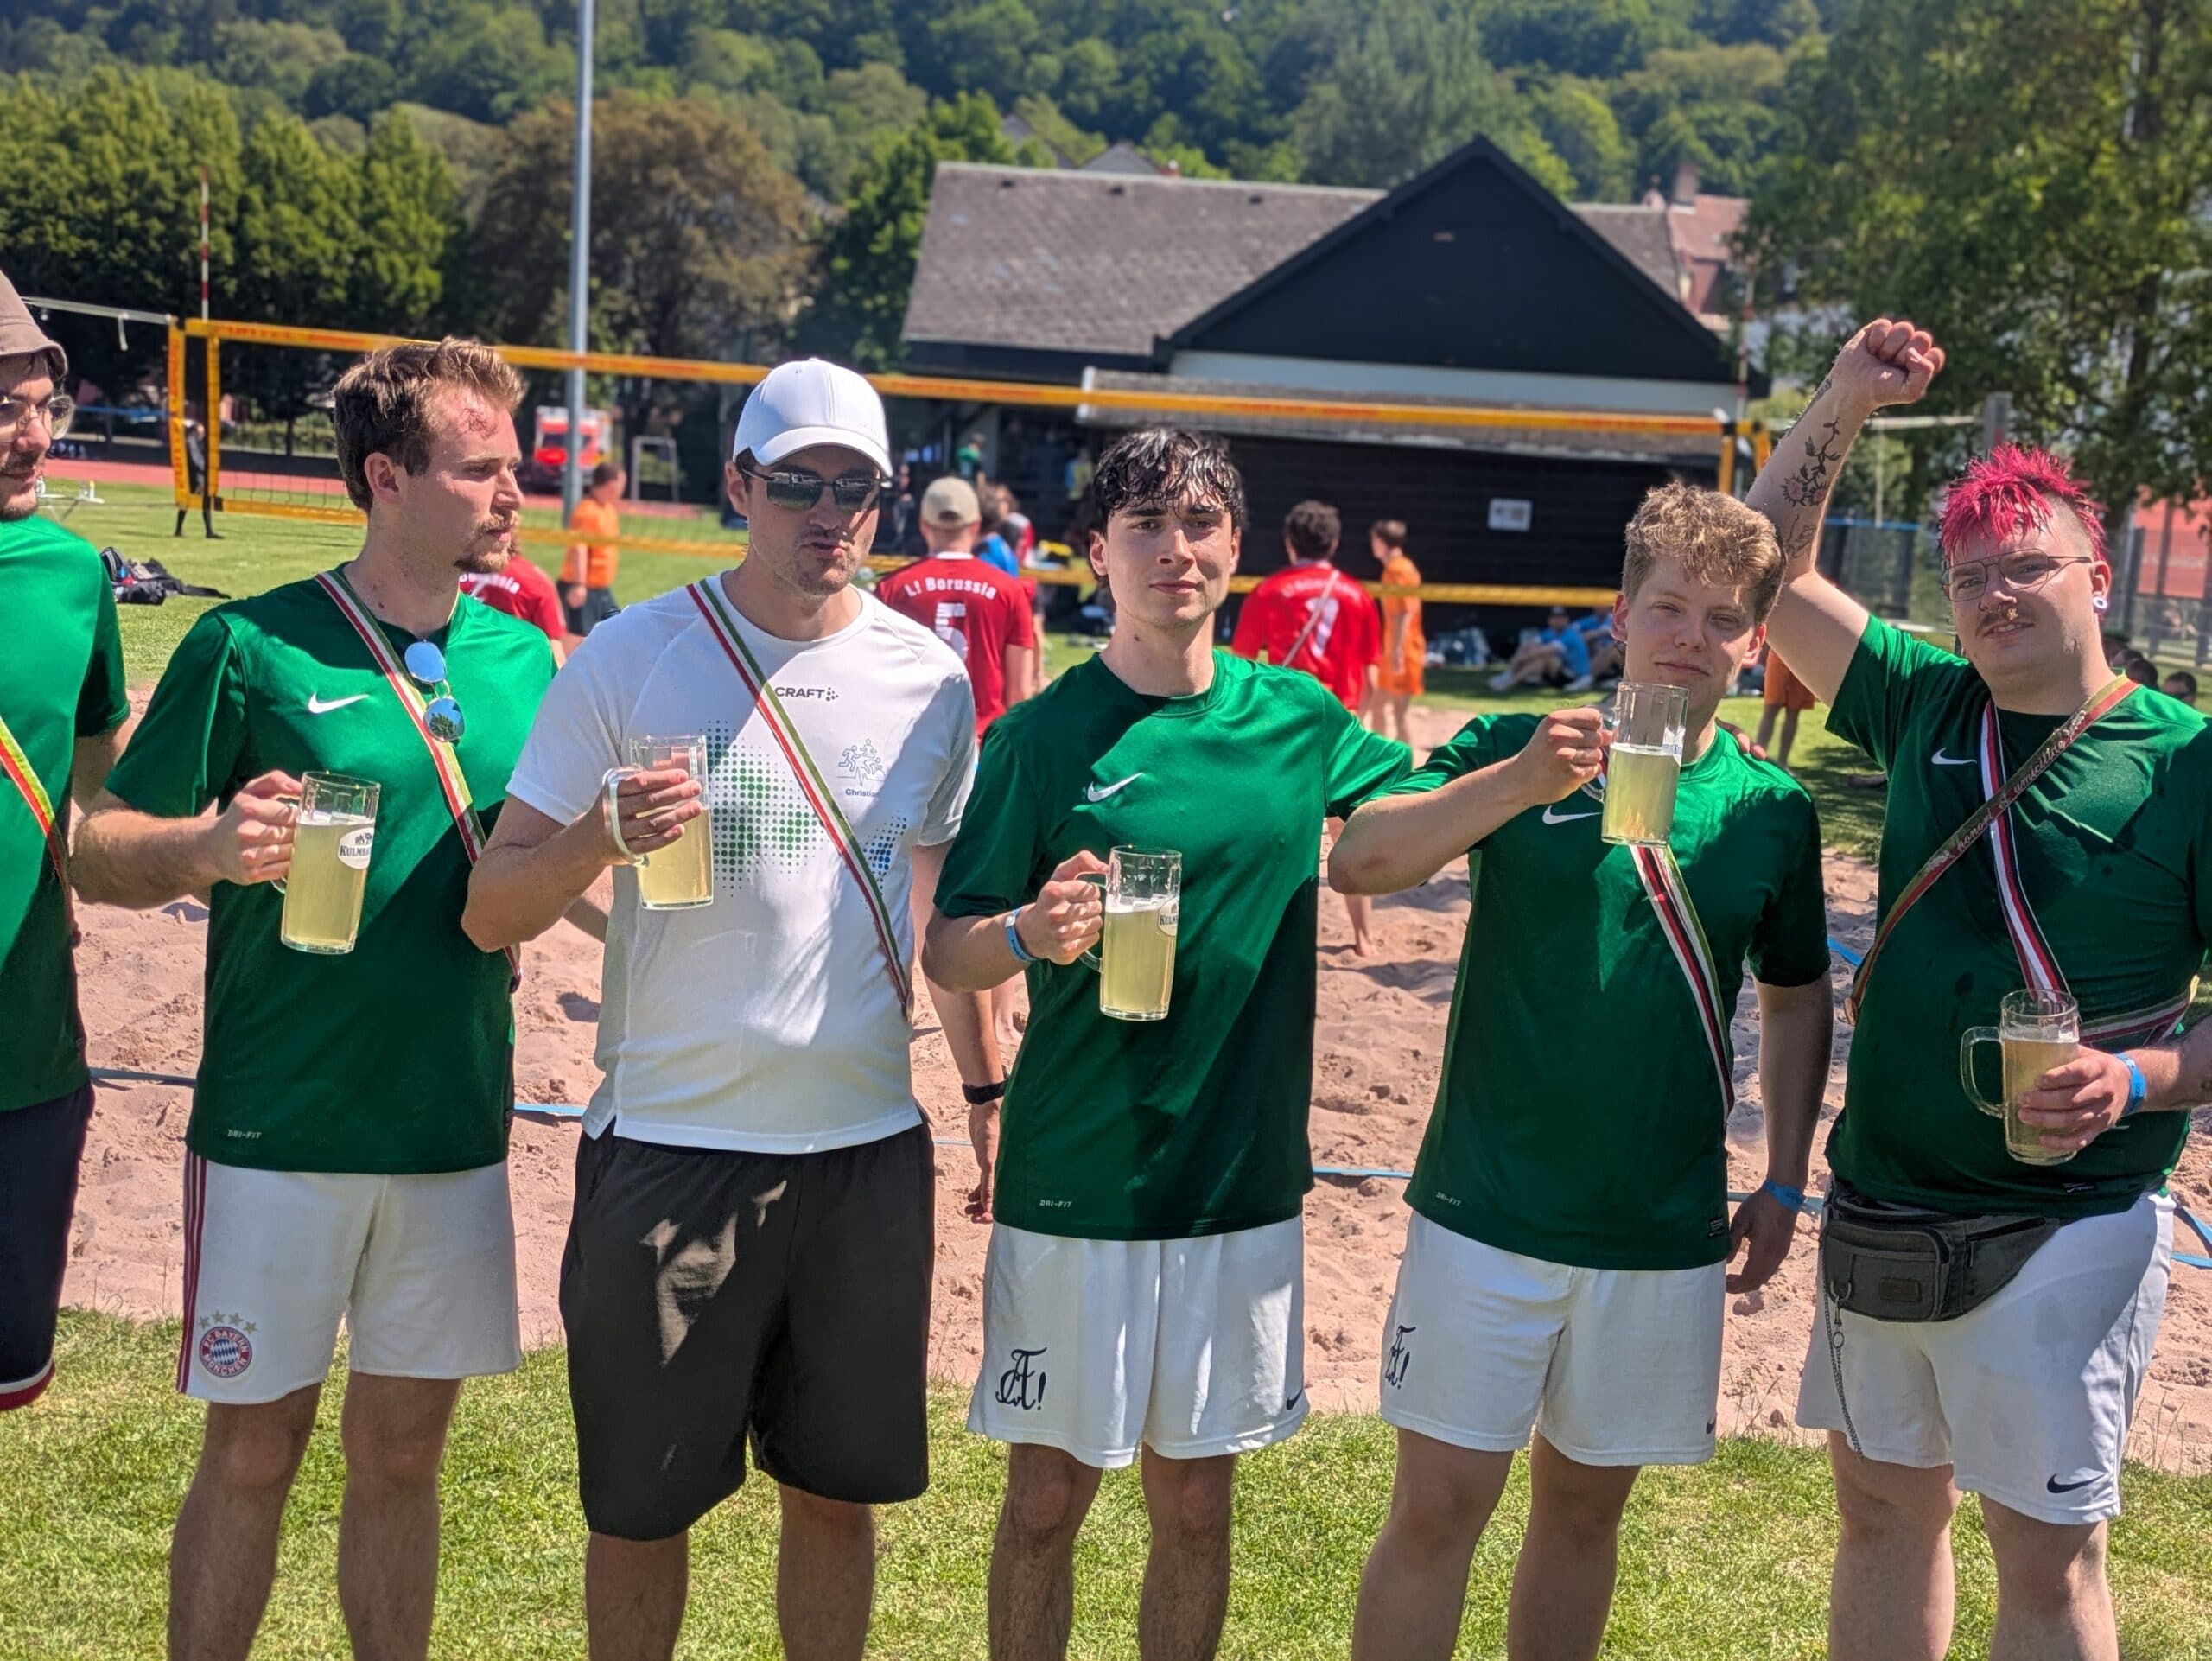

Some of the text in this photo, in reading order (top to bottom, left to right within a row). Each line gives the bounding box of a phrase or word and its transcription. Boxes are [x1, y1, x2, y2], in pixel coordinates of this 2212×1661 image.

[925, 577, 996, 600] Borussia
[935, 601, 967, 664] 5
[774, 686, 825, 699] CRAFT
[845, 788, 880, 799] Christian
[1039, 1200, 1071, 1208] DRI-FIT
[203, 1330, 248, 1352] FC BAYERN
